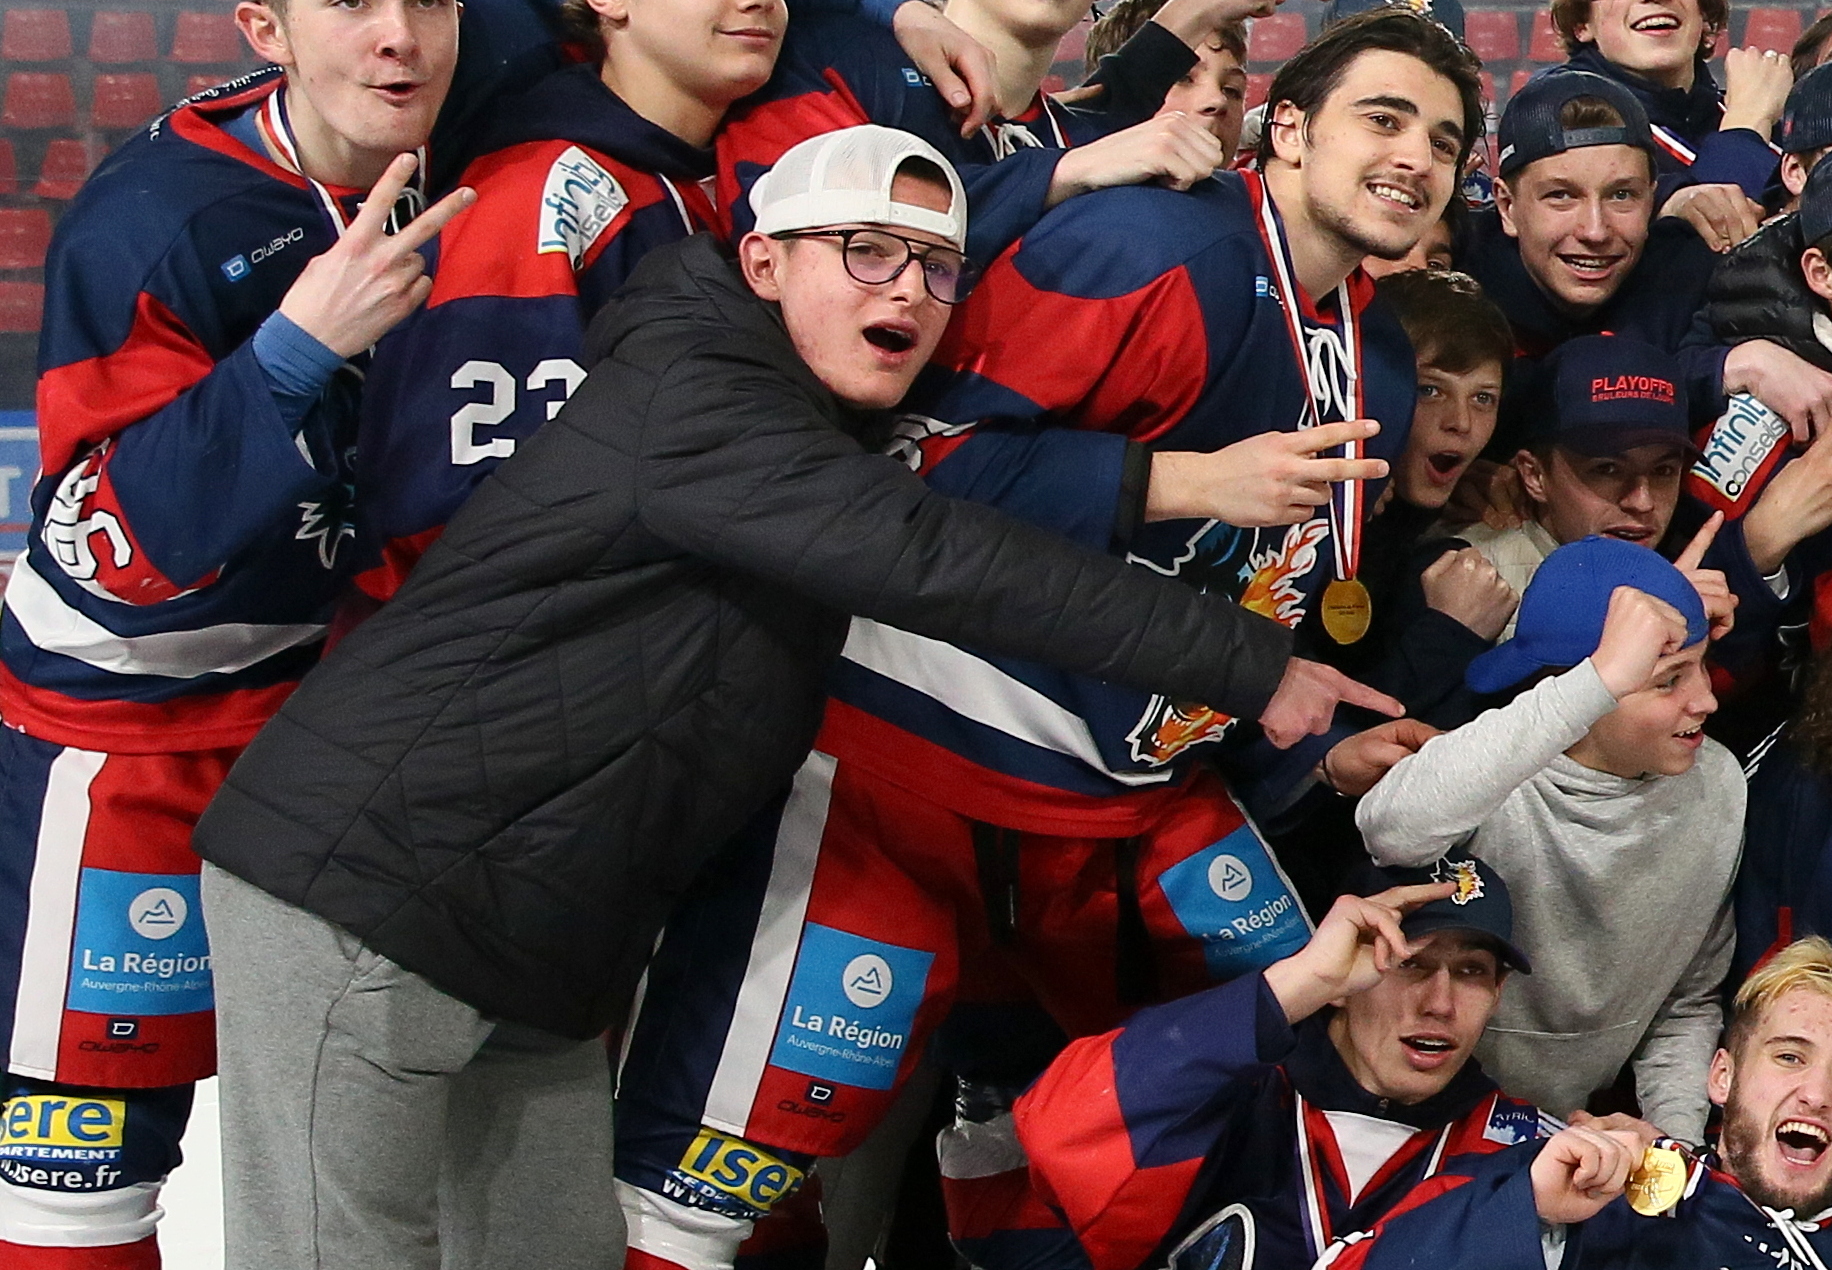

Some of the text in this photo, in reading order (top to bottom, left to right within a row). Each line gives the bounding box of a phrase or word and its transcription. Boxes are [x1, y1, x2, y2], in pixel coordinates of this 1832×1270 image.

[1592, 376, 1673, 396] PLAYOFFS
[1233, 895, 1292, 935] Région
[83, 949, 212, 980] La Région
[793, 1006, 904, 1051] La Région
[0, 1146, 120, 1161] ARTEMENT
